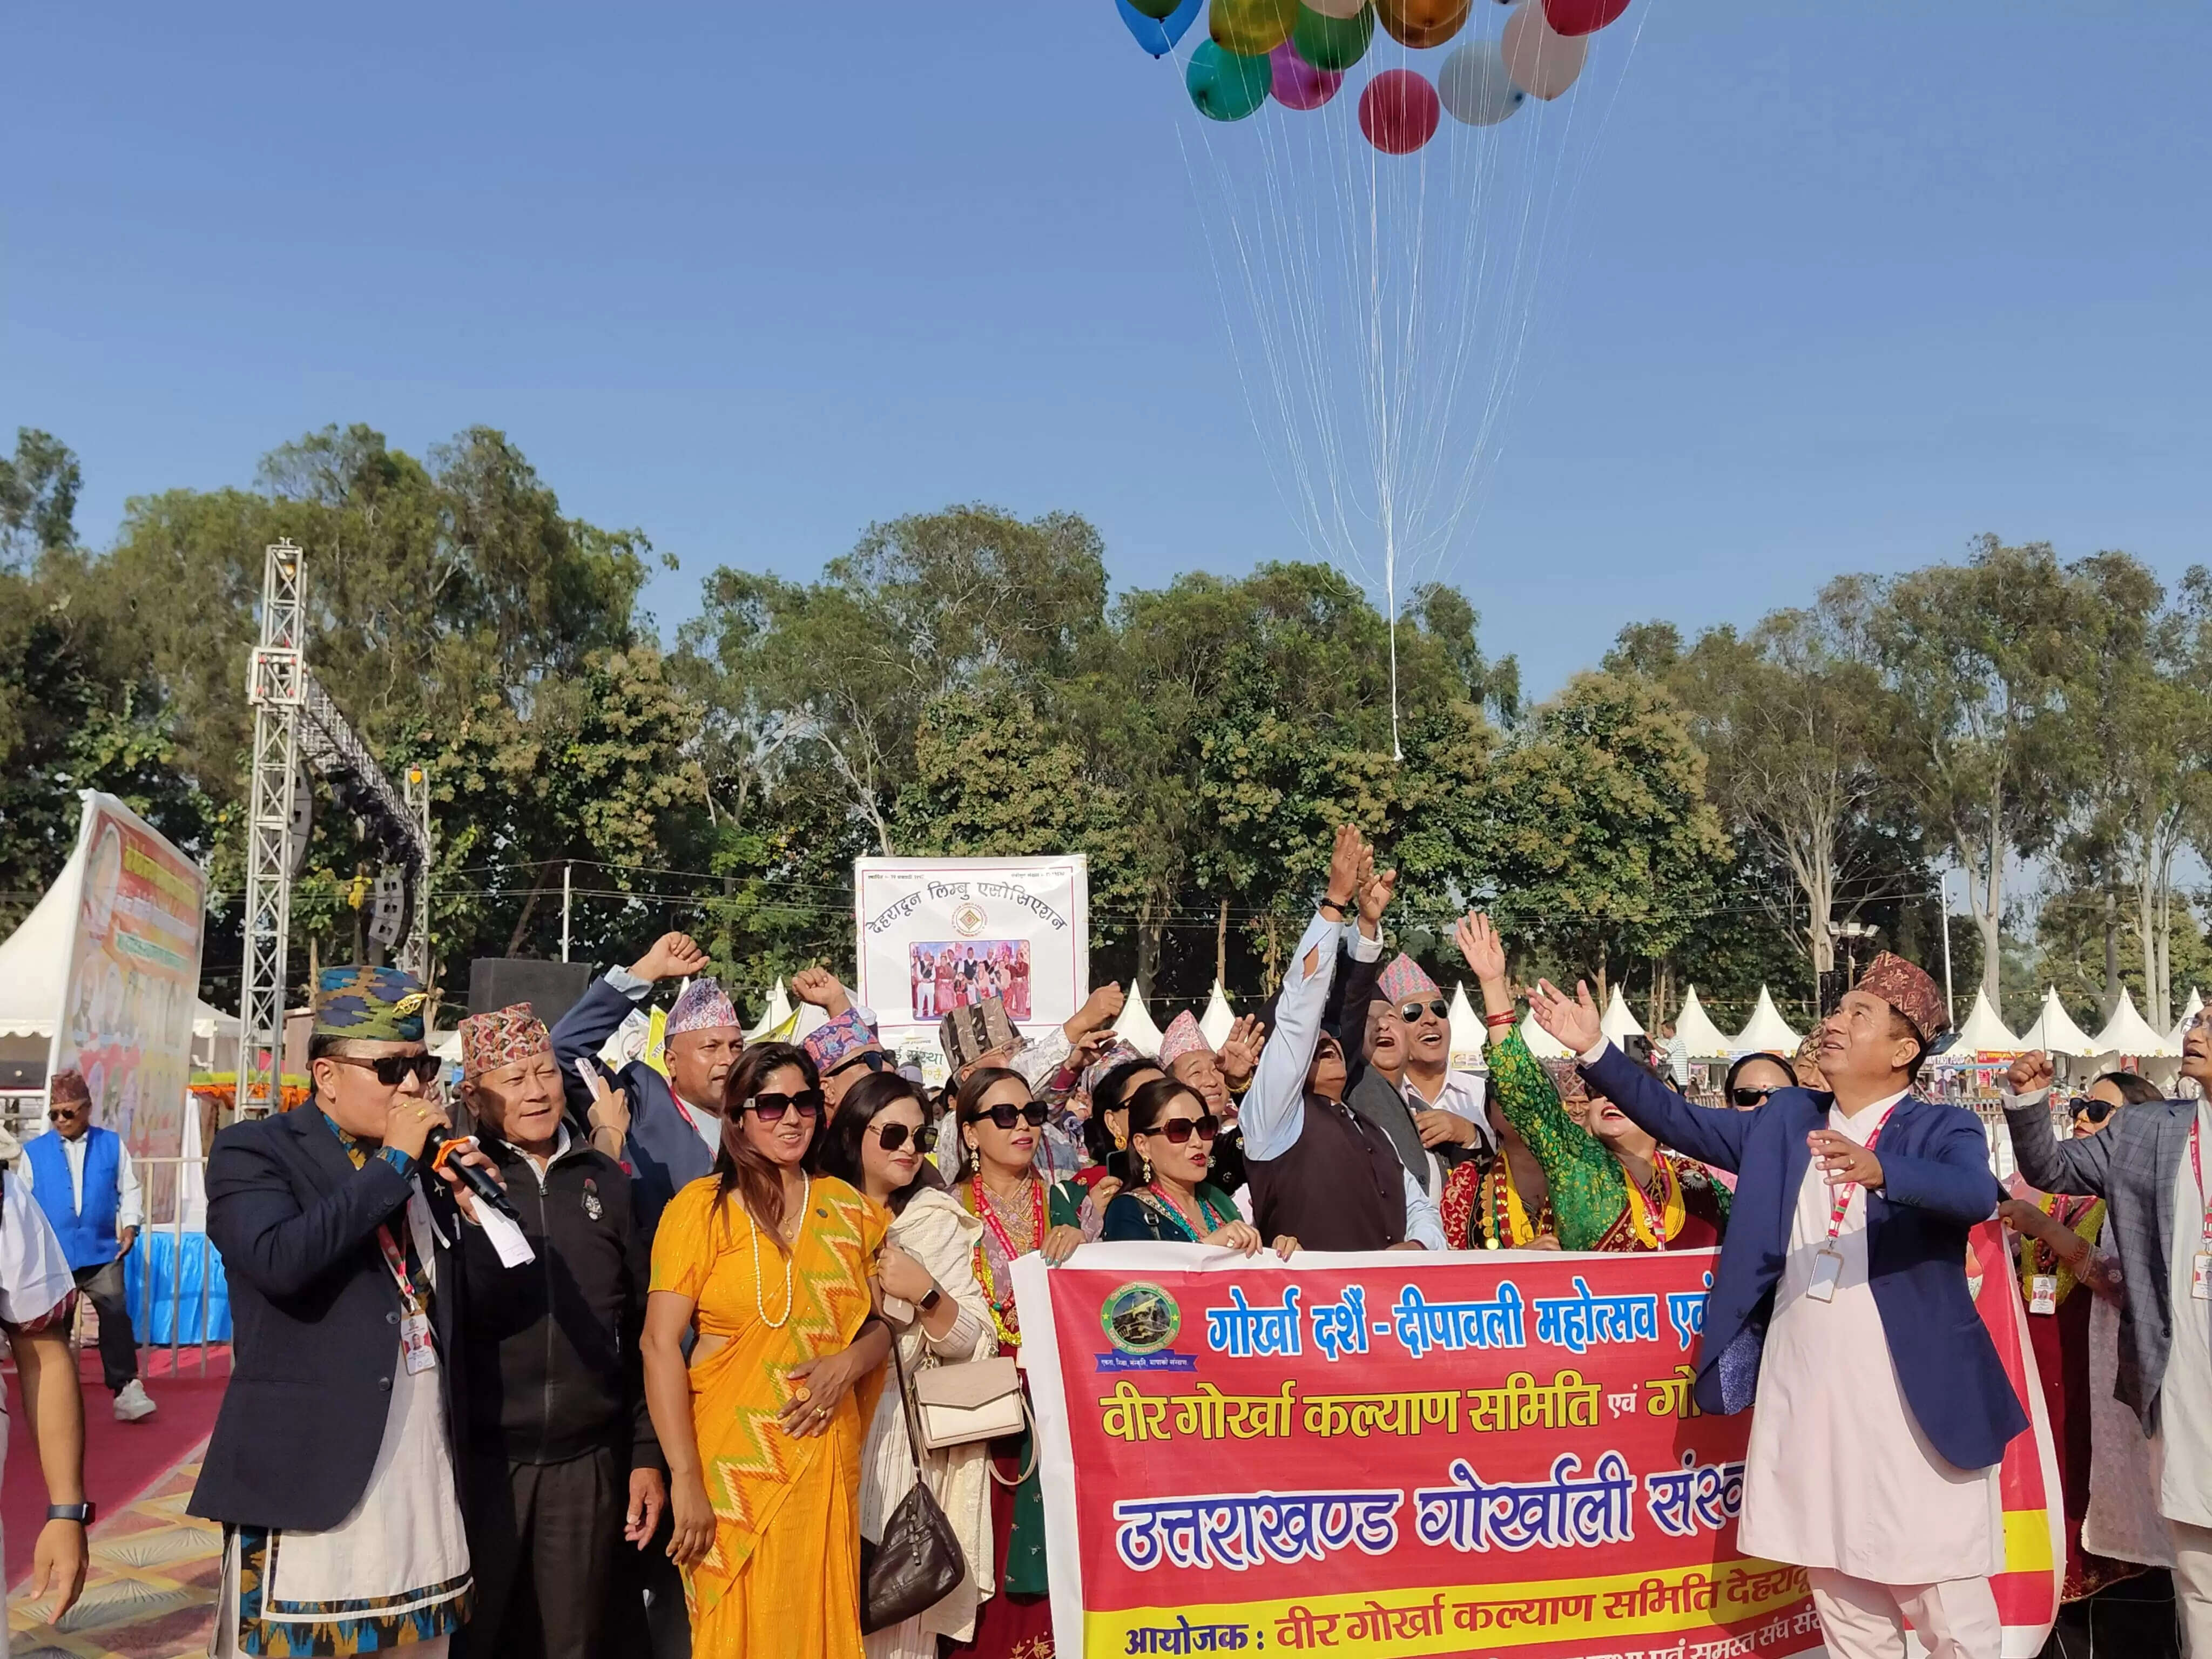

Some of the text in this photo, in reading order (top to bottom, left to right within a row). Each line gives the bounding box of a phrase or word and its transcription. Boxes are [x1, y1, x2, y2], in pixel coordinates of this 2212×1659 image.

[865, 891, 922, 933] देहरादून
[927, 881, 970, 900] लिम्बु
[977, 881, 1068, 930] एसोसिएशन
[1206, 1285, 1301, 1357] गोर्खा
[1392, 1280, 1526, 1358] दीपावली
[1533, 1276, 1657, 1353] महोत्सव
[1098, 1380, 1171, 1441] वीर
[1170, 1379, 1296, 1440] गोर्खा
[1302, 1390, 1460, 1438] कल्याण
[1467, 1370, 1601, 1433] समिति
[1607, 1384, 1638, 1419] एवं
[1114, 1489, 1404, 1571] उत्तराखण्ड
[1414, 1449, 1636, 1552] गोर्खाली
[1274, 1606, 1340, 1649] वीर
[1345, 1593, 1446, 1641] गोर्खा
[1452, 1594, 1597, 1631] कल्याण
[1603, 1573, 1721, 1619] समिति
[1727, 1564, 1811, 1603] देहरादू
[1759, 1616, 1790, 1645] संघ
